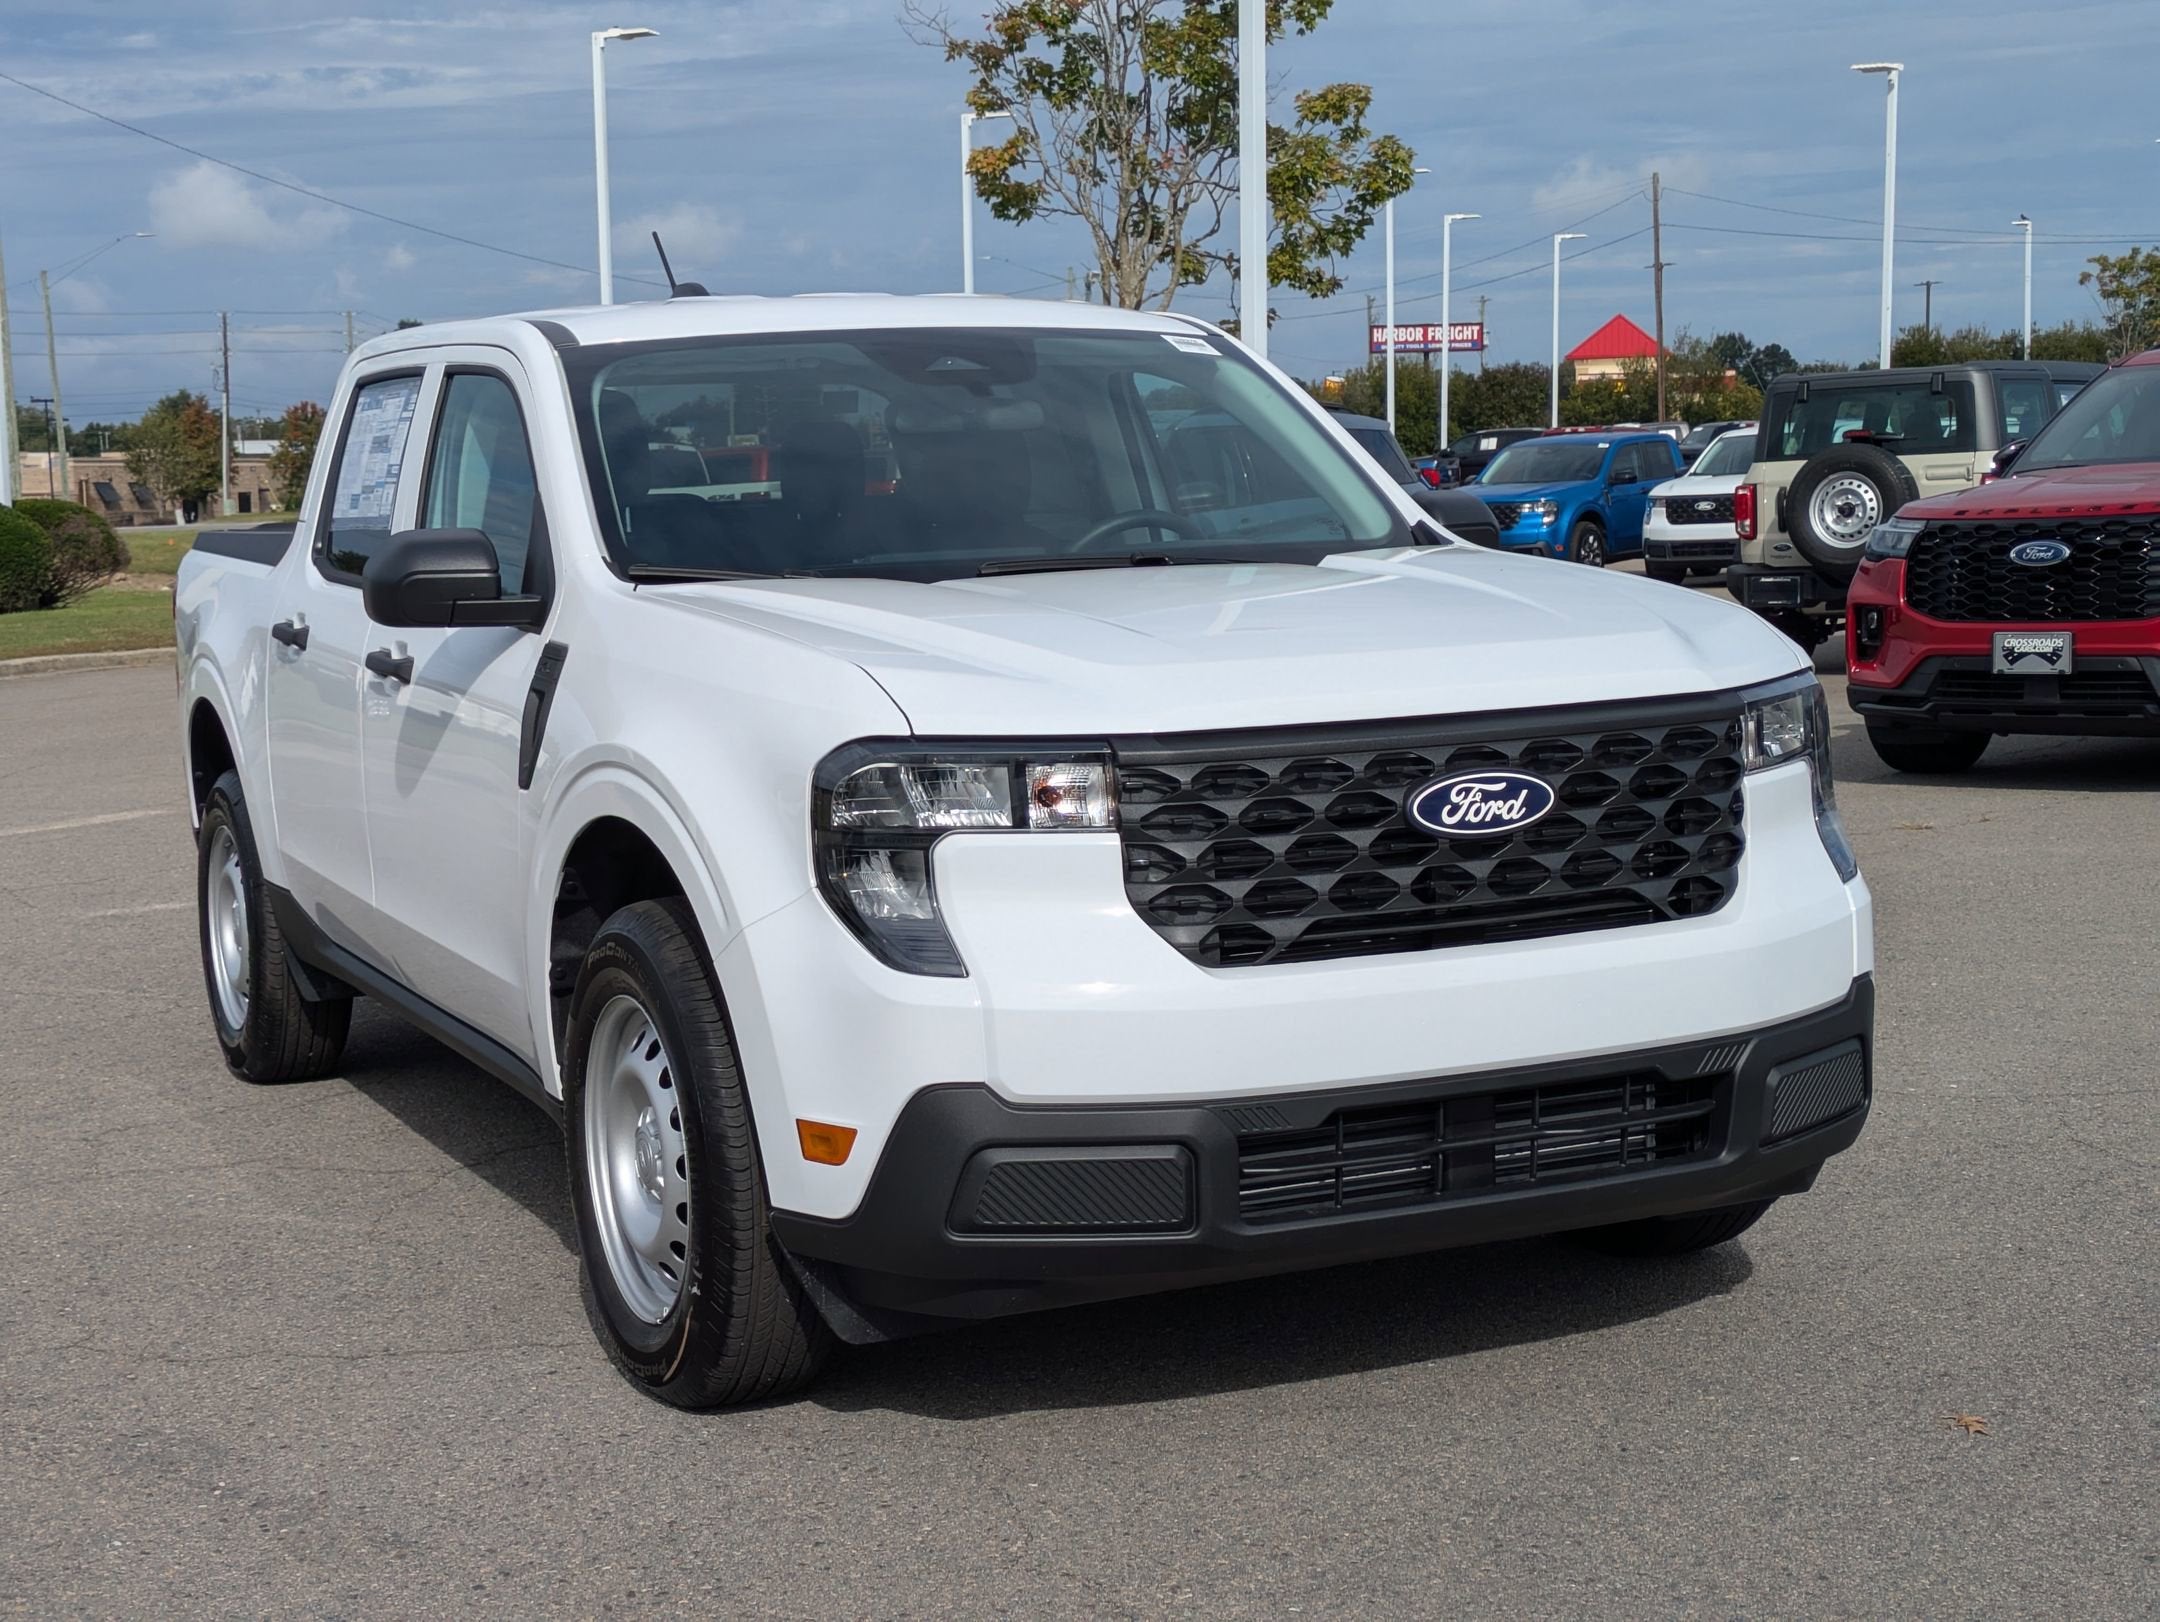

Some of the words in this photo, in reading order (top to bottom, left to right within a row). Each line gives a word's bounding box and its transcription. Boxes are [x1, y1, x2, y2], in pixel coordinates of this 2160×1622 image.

[1373, 327, 1424, 343] HARBOR
[1427, 325, 1480, 341] FRIGHT
[2022, 546, 2055, 560] Ford
[2004, 638, 2064, 647] CROSSROADS
[1441, 782, 1528, 825] Ford
